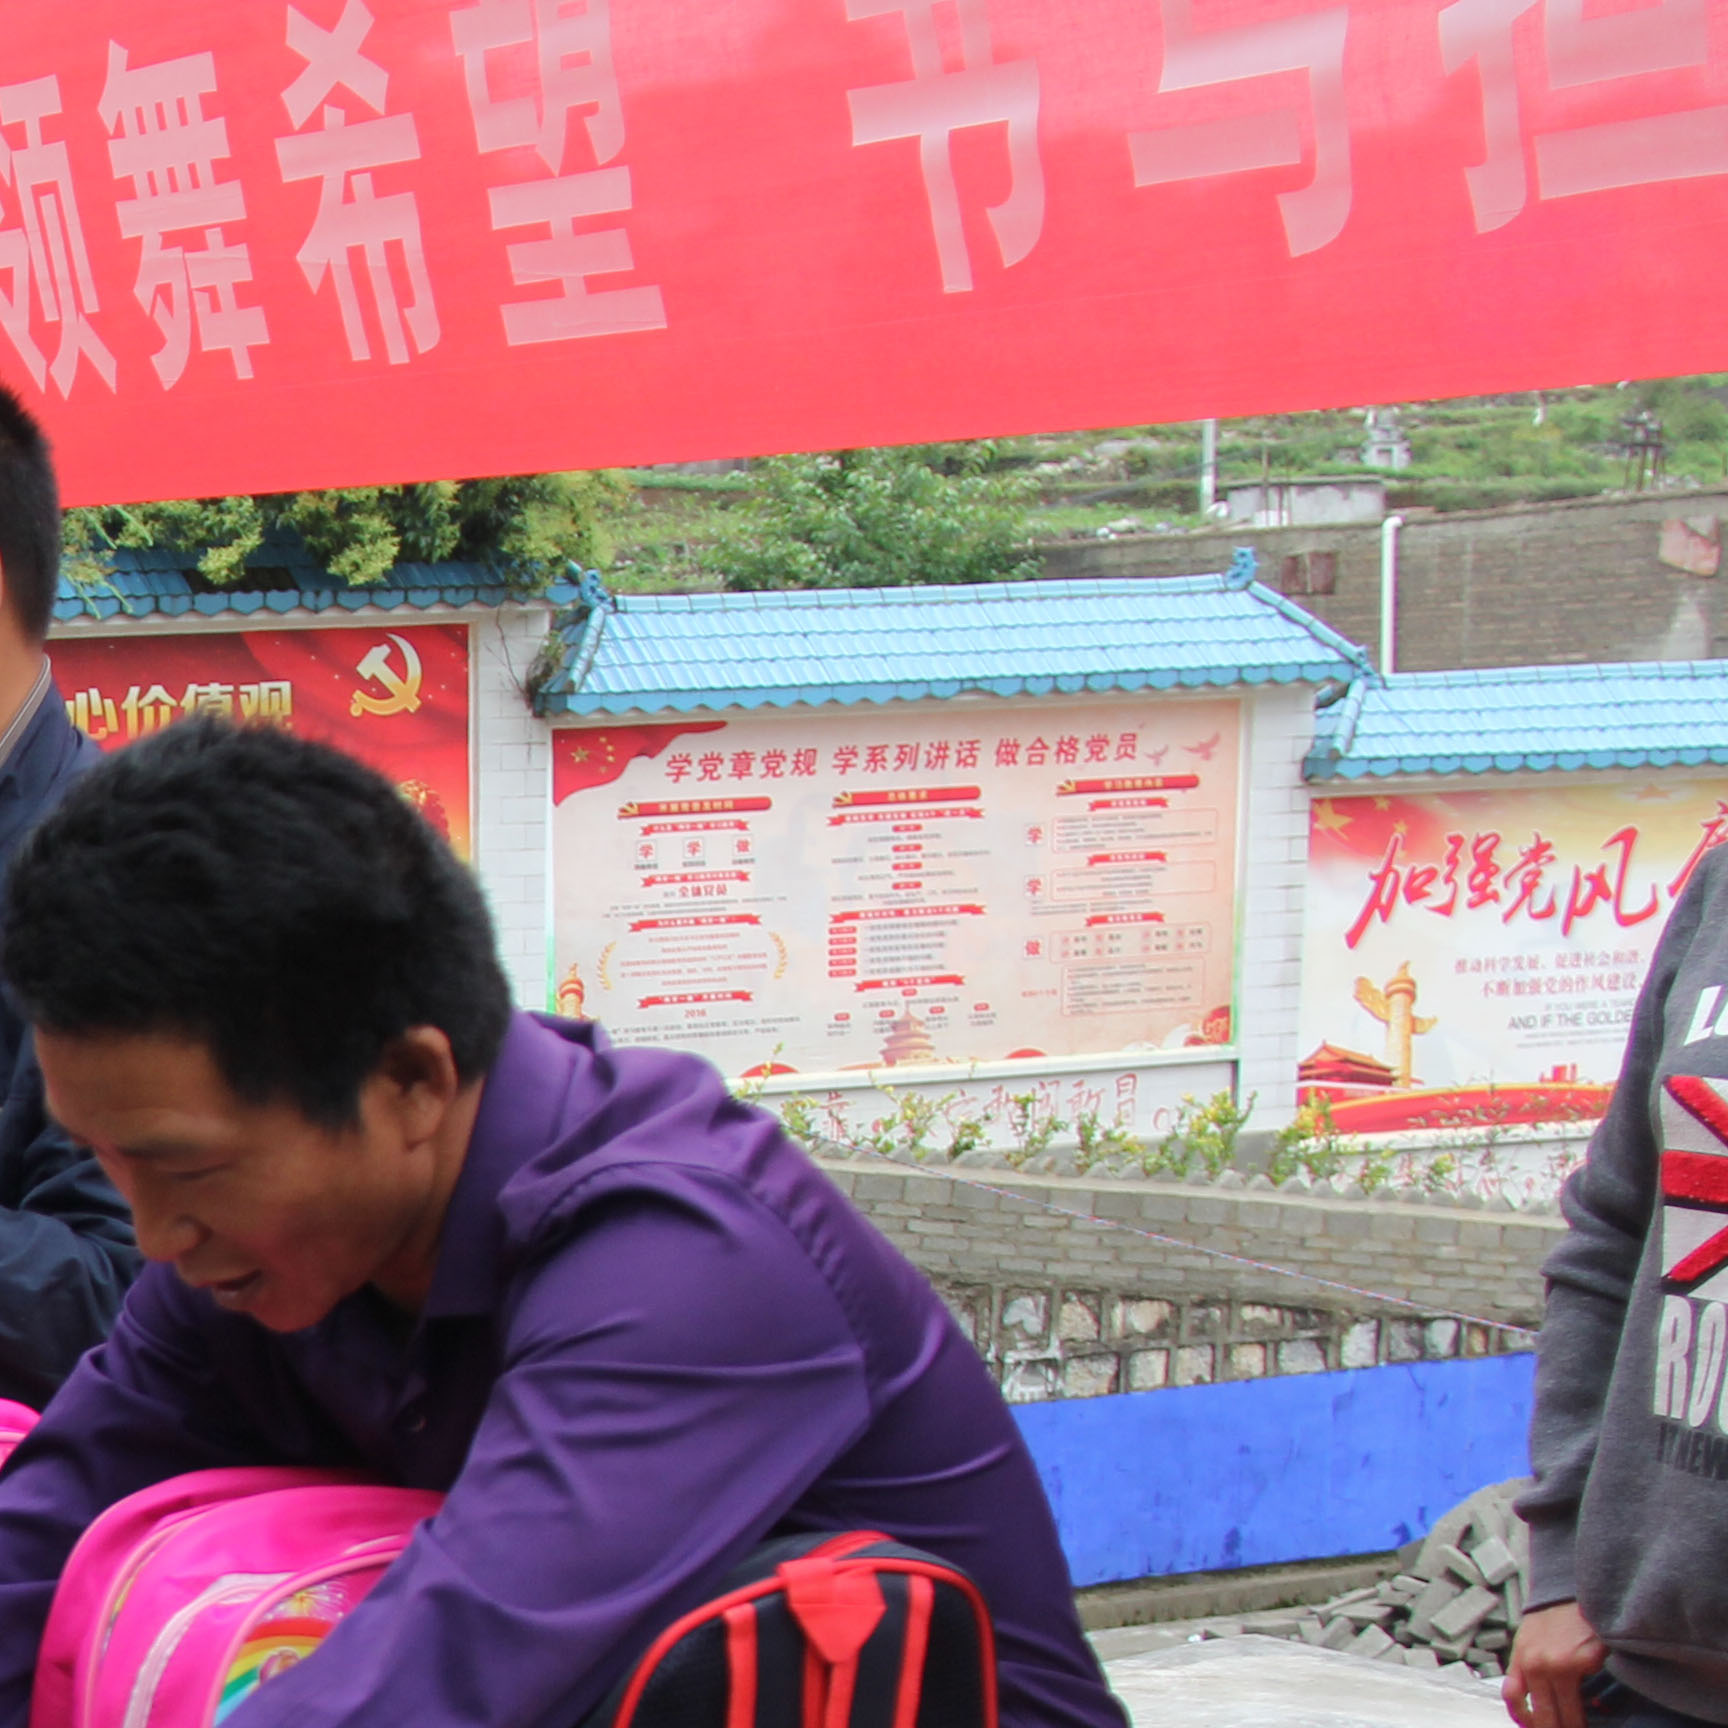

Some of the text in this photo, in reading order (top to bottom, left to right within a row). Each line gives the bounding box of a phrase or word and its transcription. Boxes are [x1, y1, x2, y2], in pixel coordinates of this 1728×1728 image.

[664, 731, 1139, 783] 学党章党规 学系列讲话 做合格党员
[1508, 1015, 1537, 1029] AND
[1541, 1014, 1552, 1027] IF
[1557, 1012, 1583, 1026] THE
[1684, 985, 1728, 1047] L
[1654, 1294, 1728, 1435] RO
